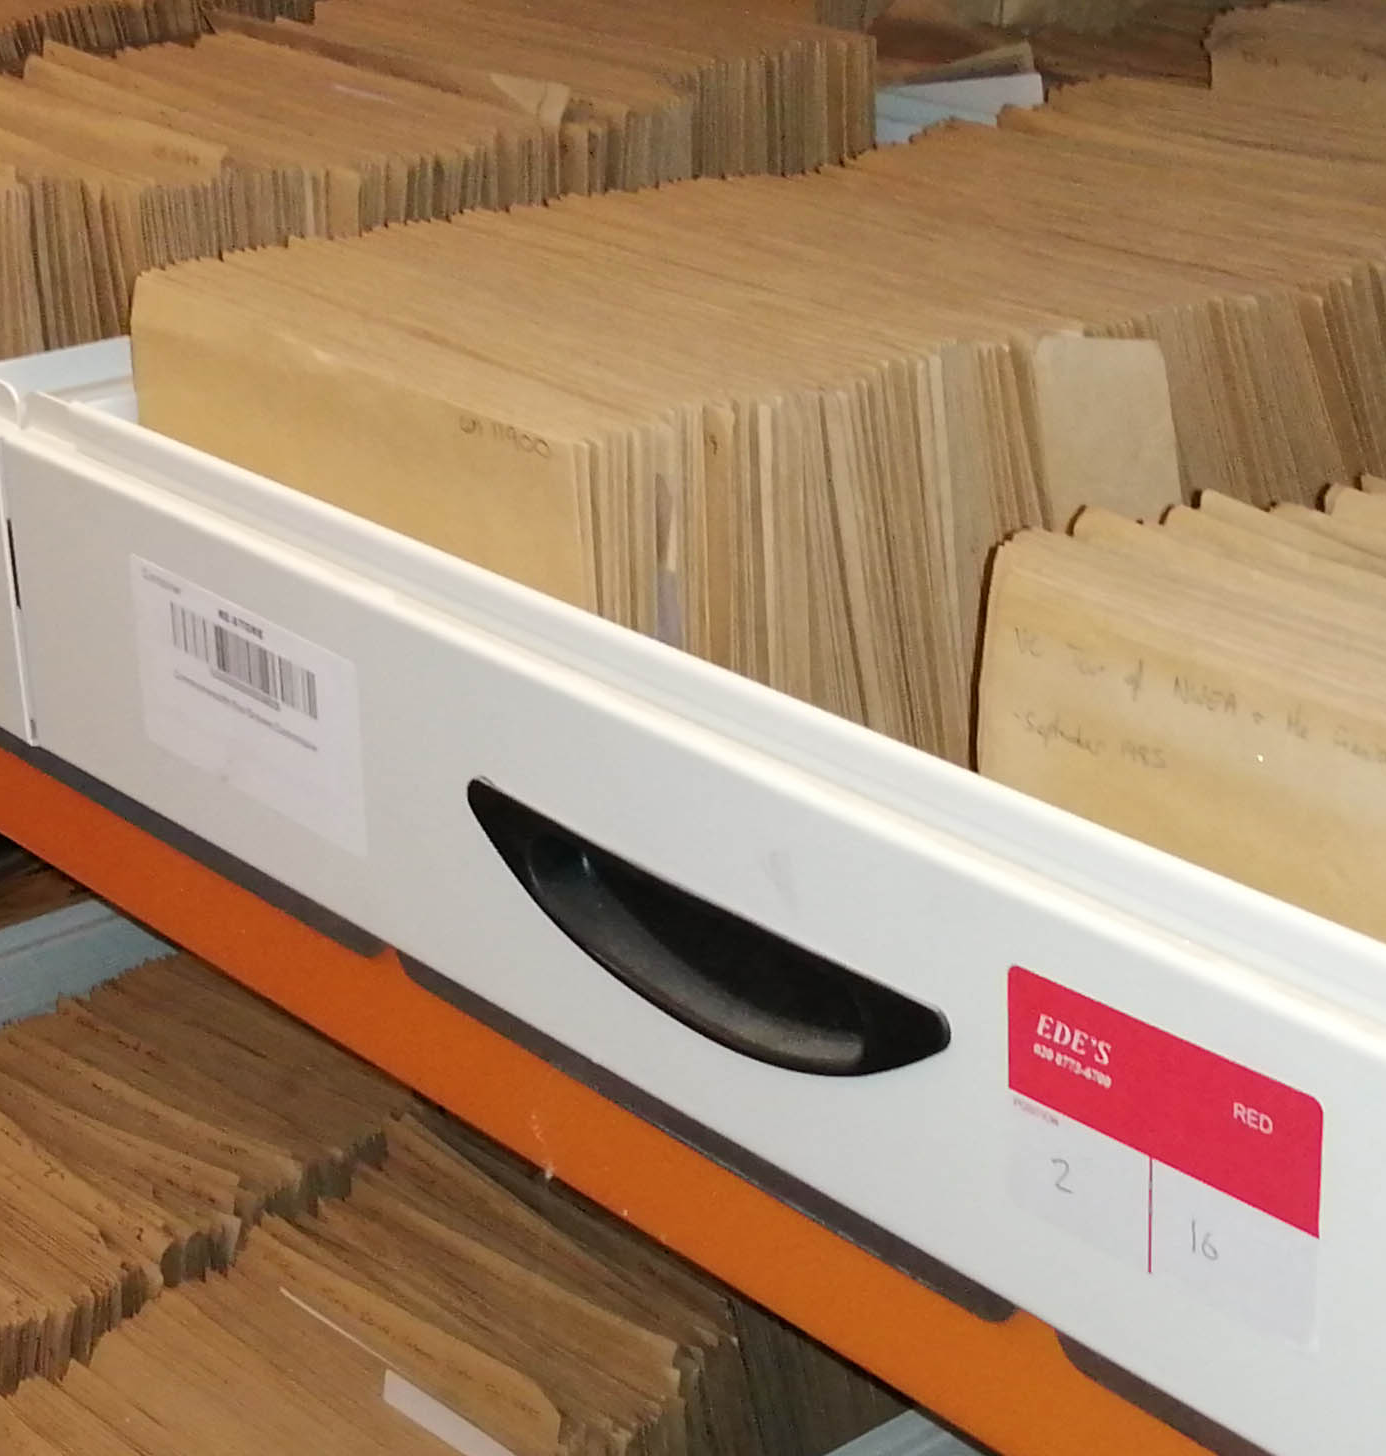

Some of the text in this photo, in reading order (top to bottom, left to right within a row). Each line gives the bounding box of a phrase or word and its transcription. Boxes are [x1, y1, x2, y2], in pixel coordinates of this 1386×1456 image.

[1036, 1013, 1112, 1066] EDE'S
[1233, 1101, 1274, 1135] RED
[1050, 1157, 1074, 1194] 2
[1190, 1217, 1219, 1261] 16
